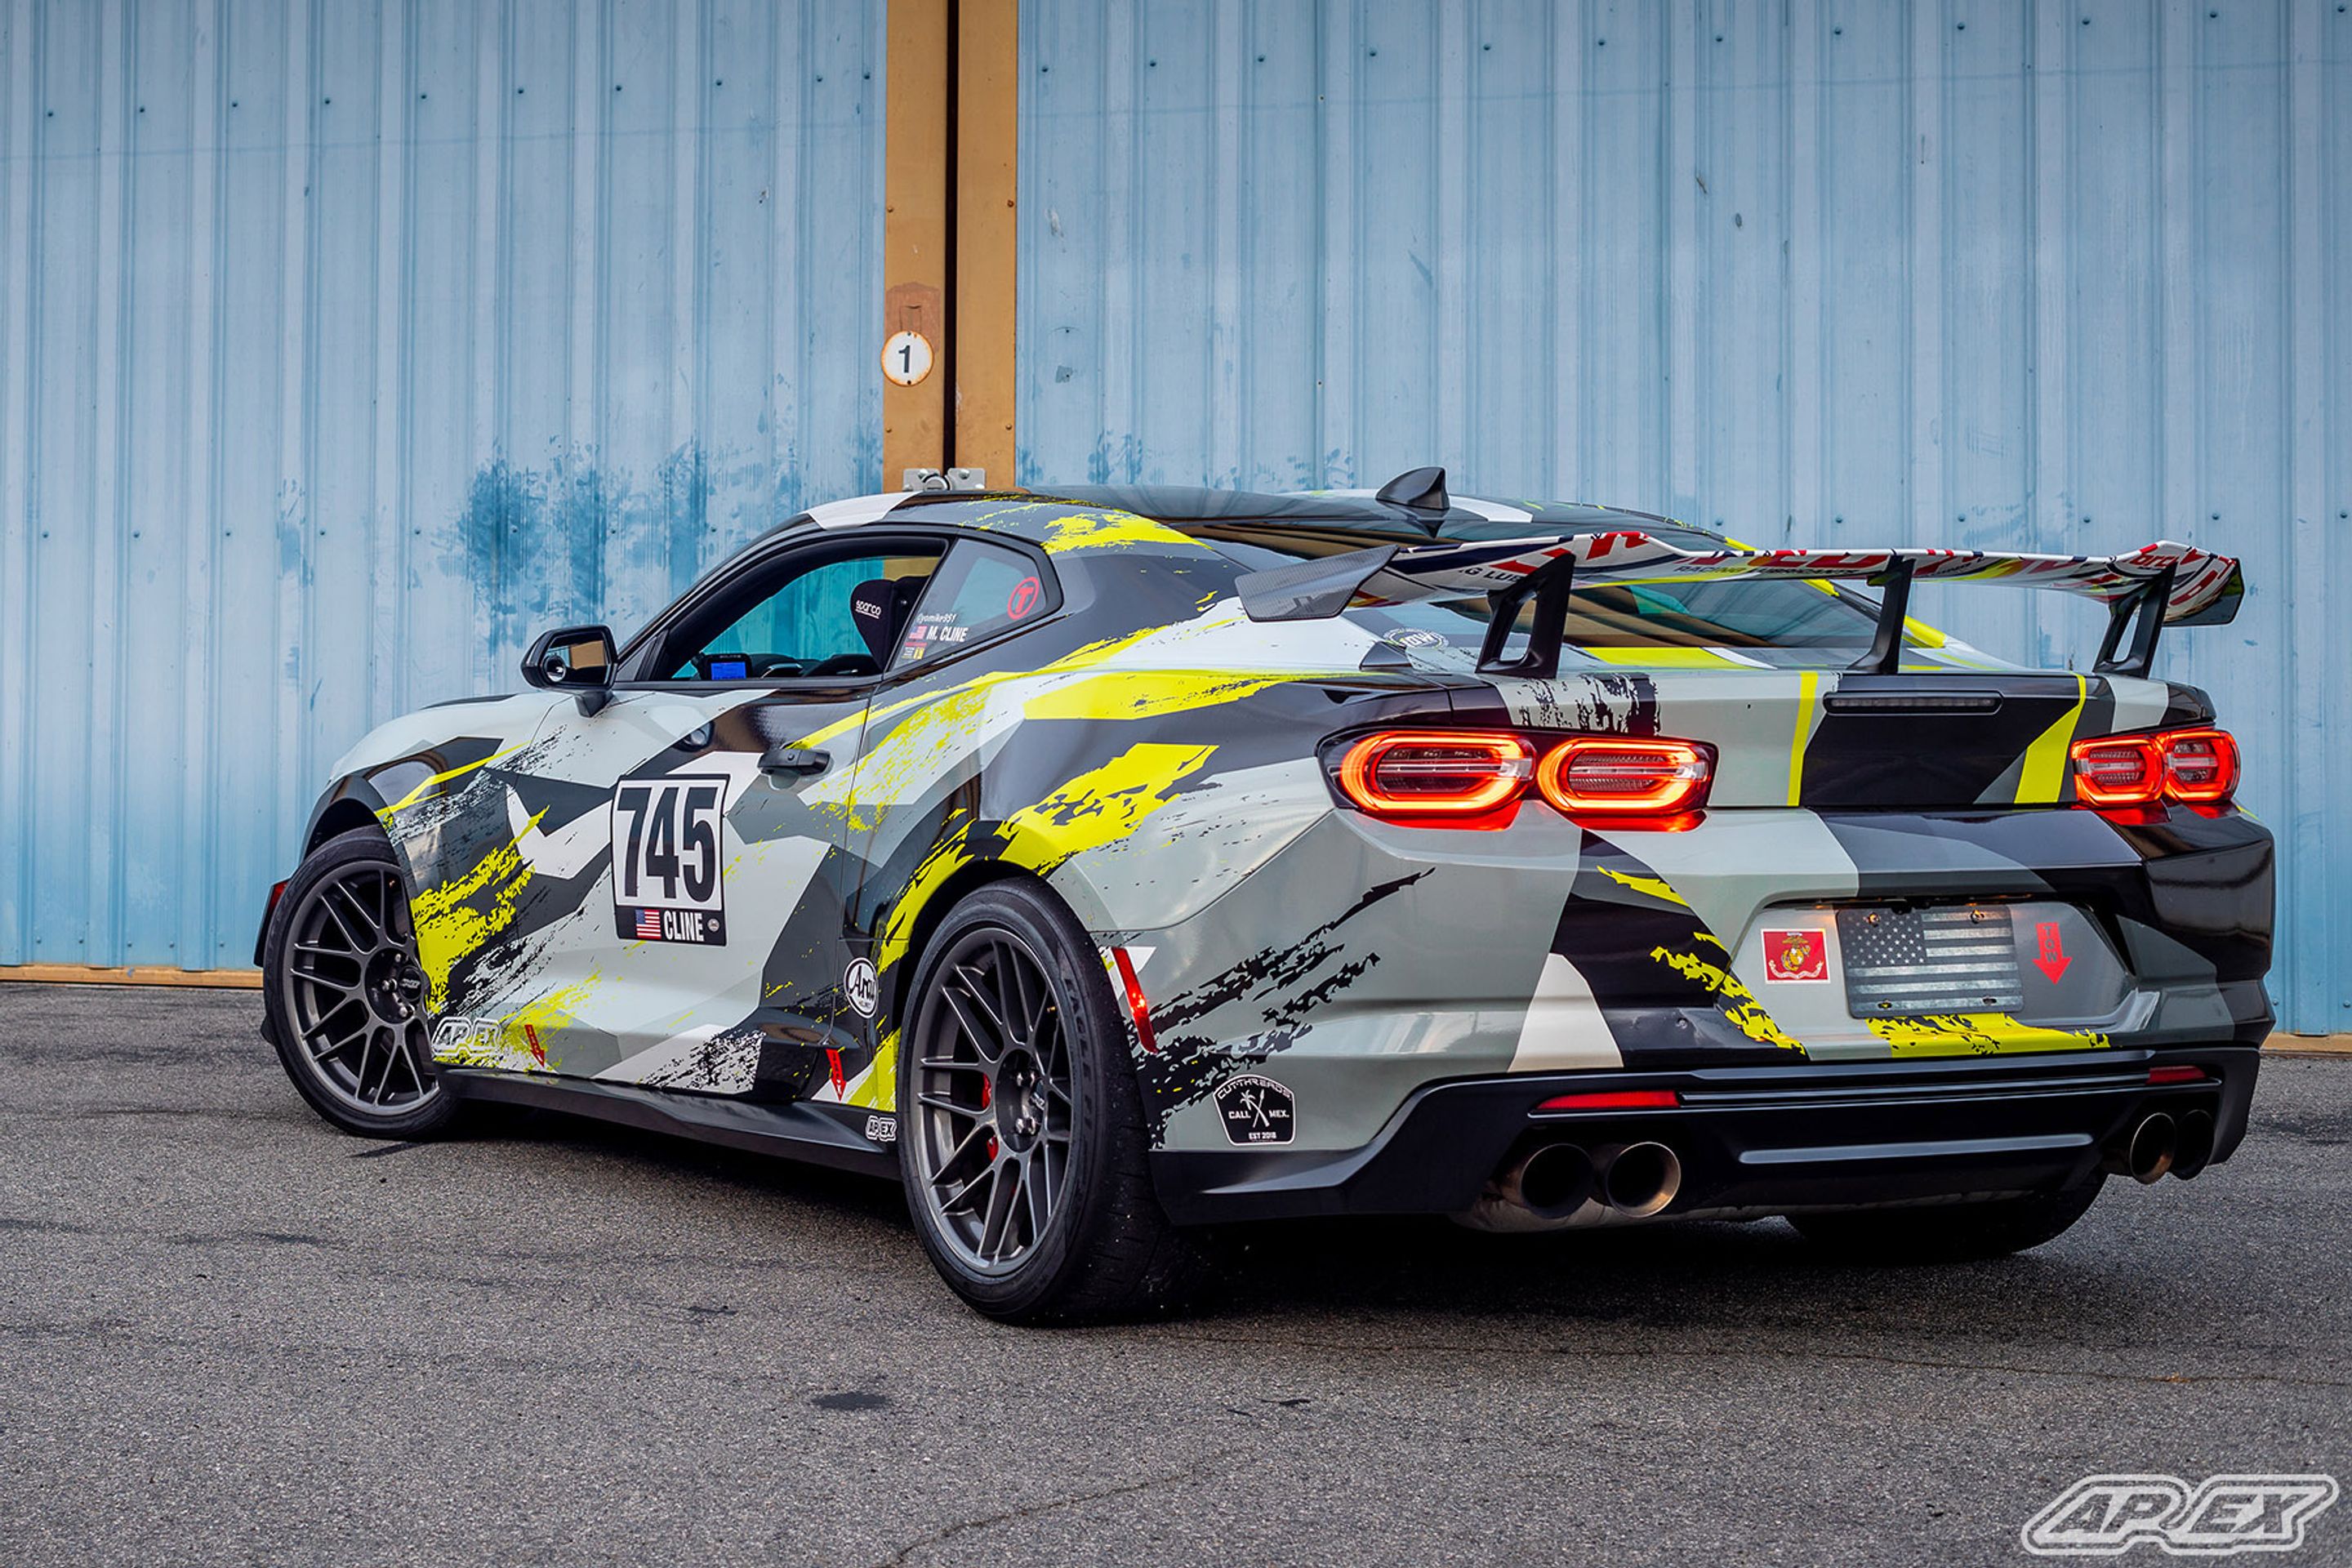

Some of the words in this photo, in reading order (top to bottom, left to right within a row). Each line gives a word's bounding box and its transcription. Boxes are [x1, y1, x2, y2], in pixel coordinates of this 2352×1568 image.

[898, 345, 911, 373] 1
[856, 600, 882, 617] sparco
[926, 626, 938, 640] M.
[939, 626, 969, 642] CLINE
[617, 786, 719, 902] 745
[663, 911, 705, 941] CLINE
[2043, 925, 2058, 963] TOW
[434, 1022, 500, 1051] APEX
[867, 1117, 896, 1139] APEX
